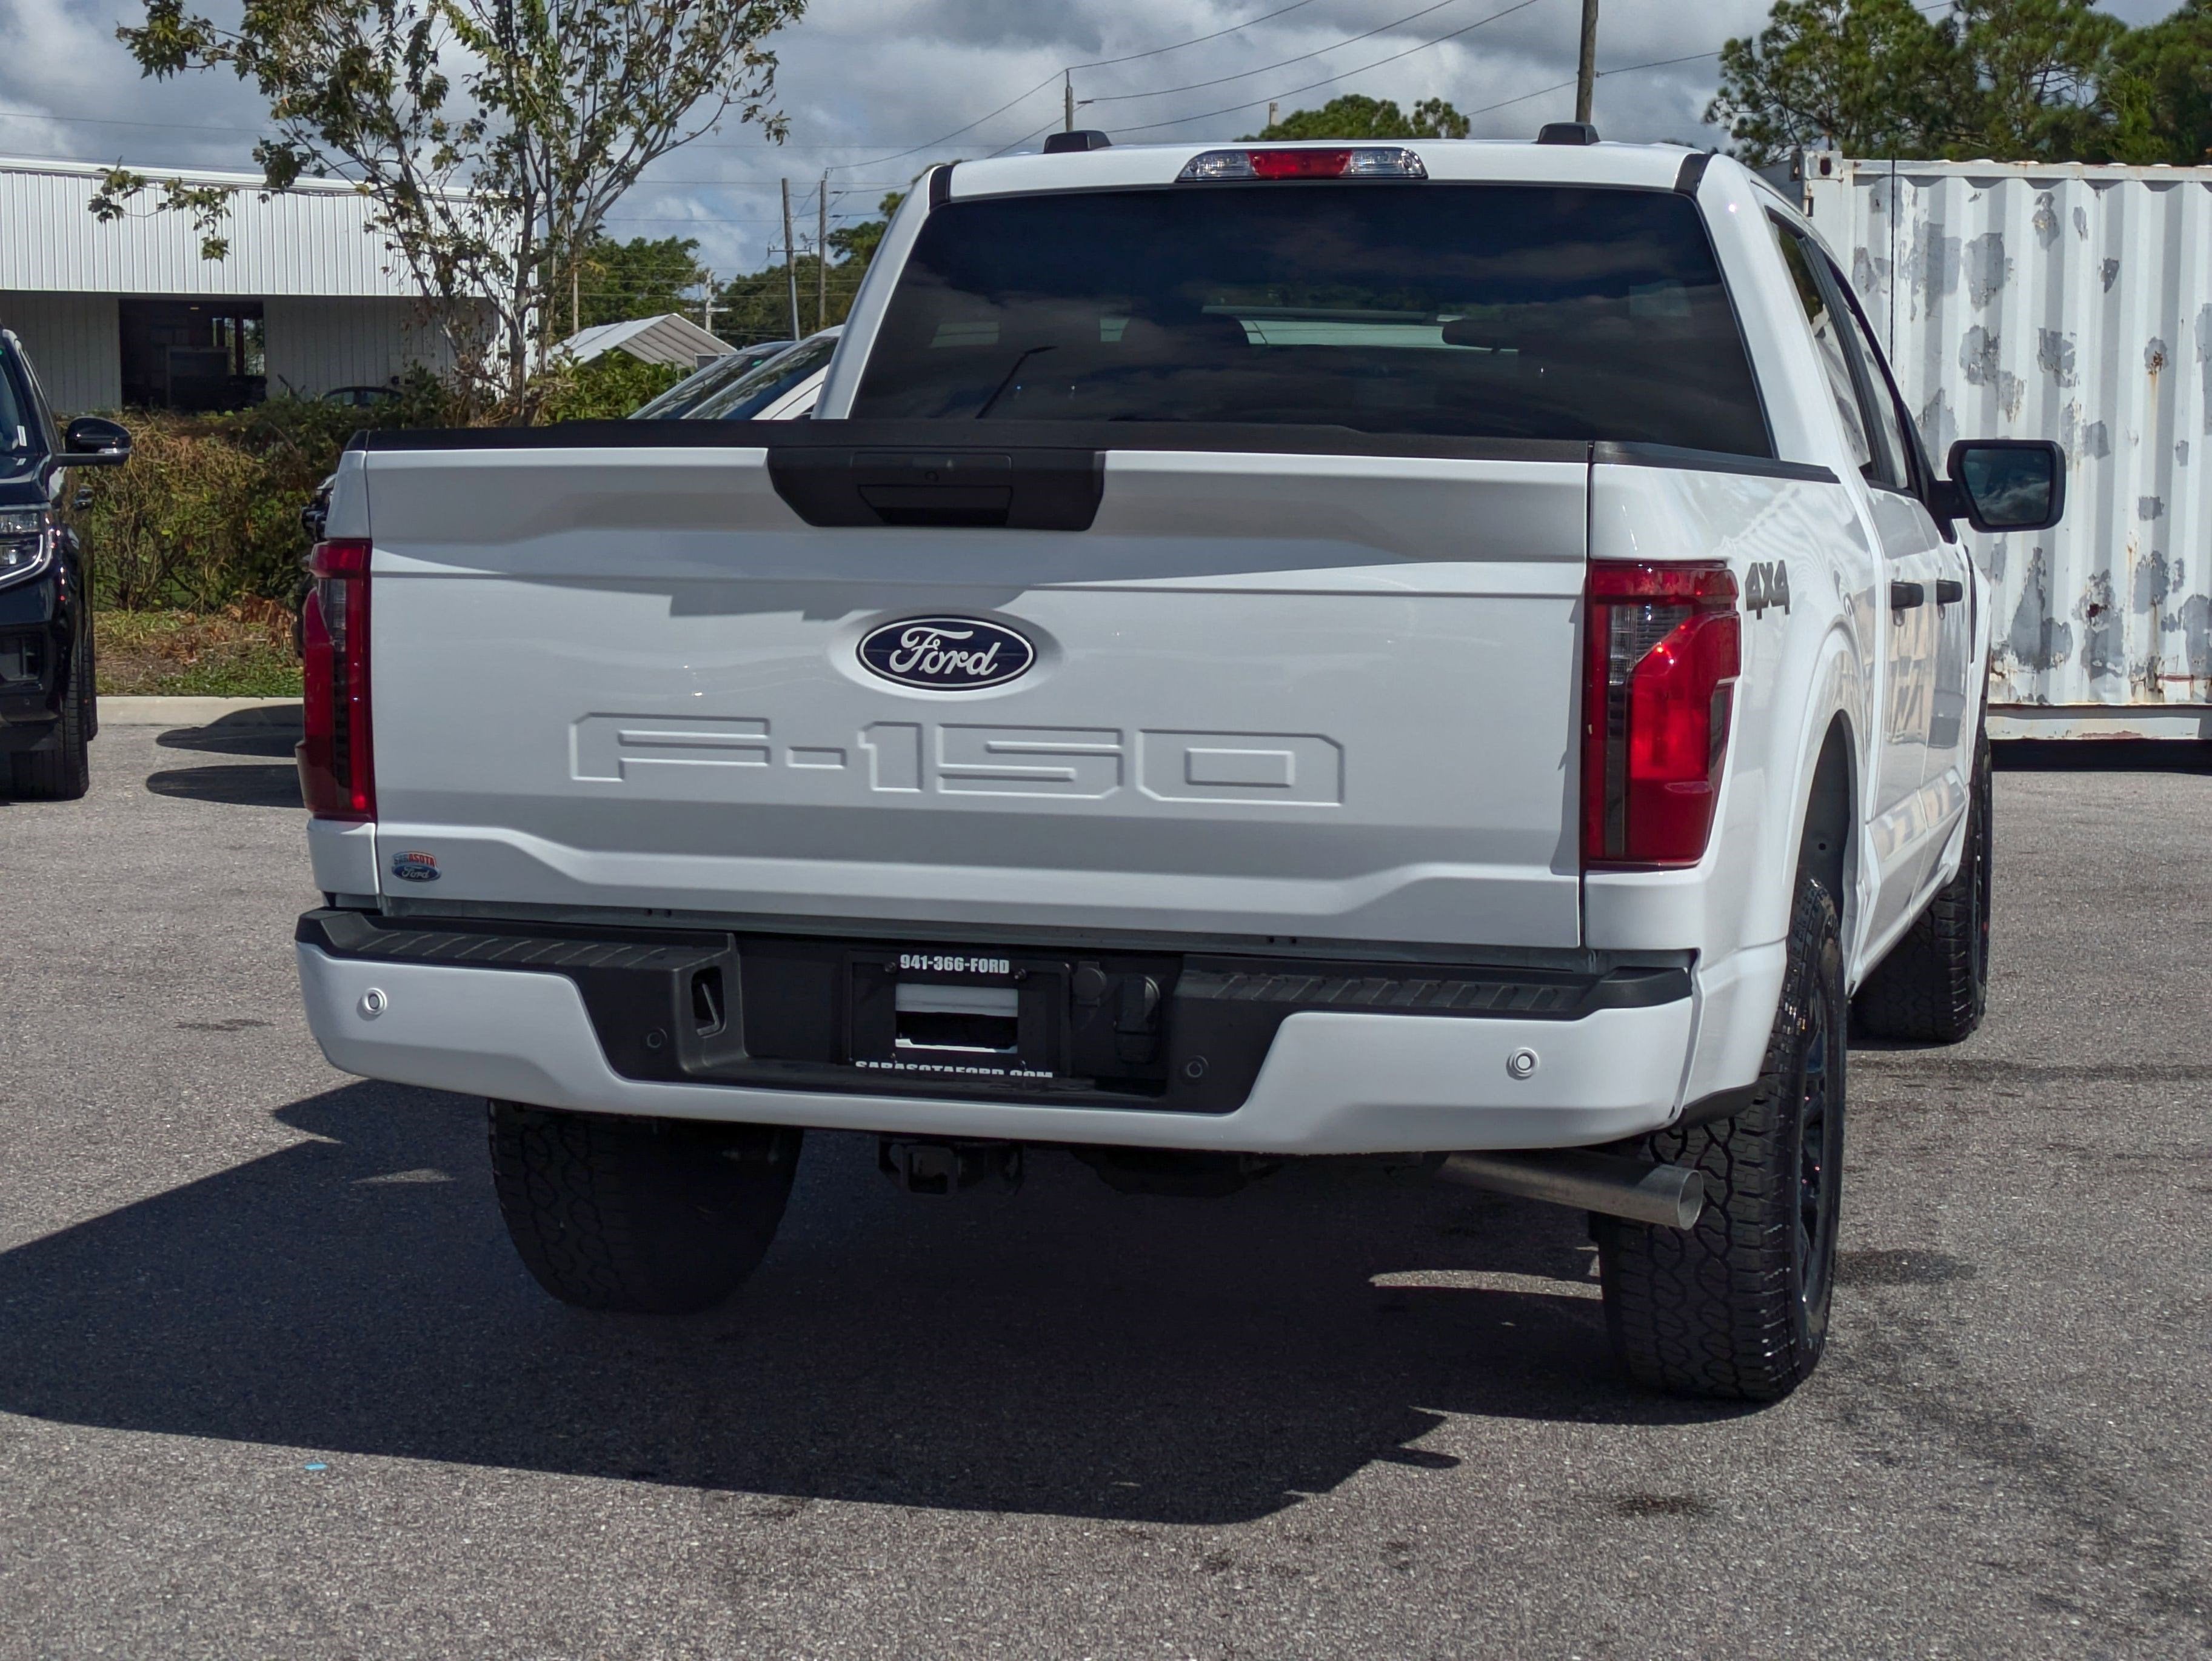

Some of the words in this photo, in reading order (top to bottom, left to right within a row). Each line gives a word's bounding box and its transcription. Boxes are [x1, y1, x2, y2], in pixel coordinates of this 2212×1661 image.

[1745, 560, 1790, 620] 4X4
[889, 627, 1001, 675] Ford
[569, 712, 1345, 807] F-150
[394, 853, 435, 867] SARASOTA
[402, 866, 430, 878] Ford
[900, 954, 1009, 974] 941-366-FORD
